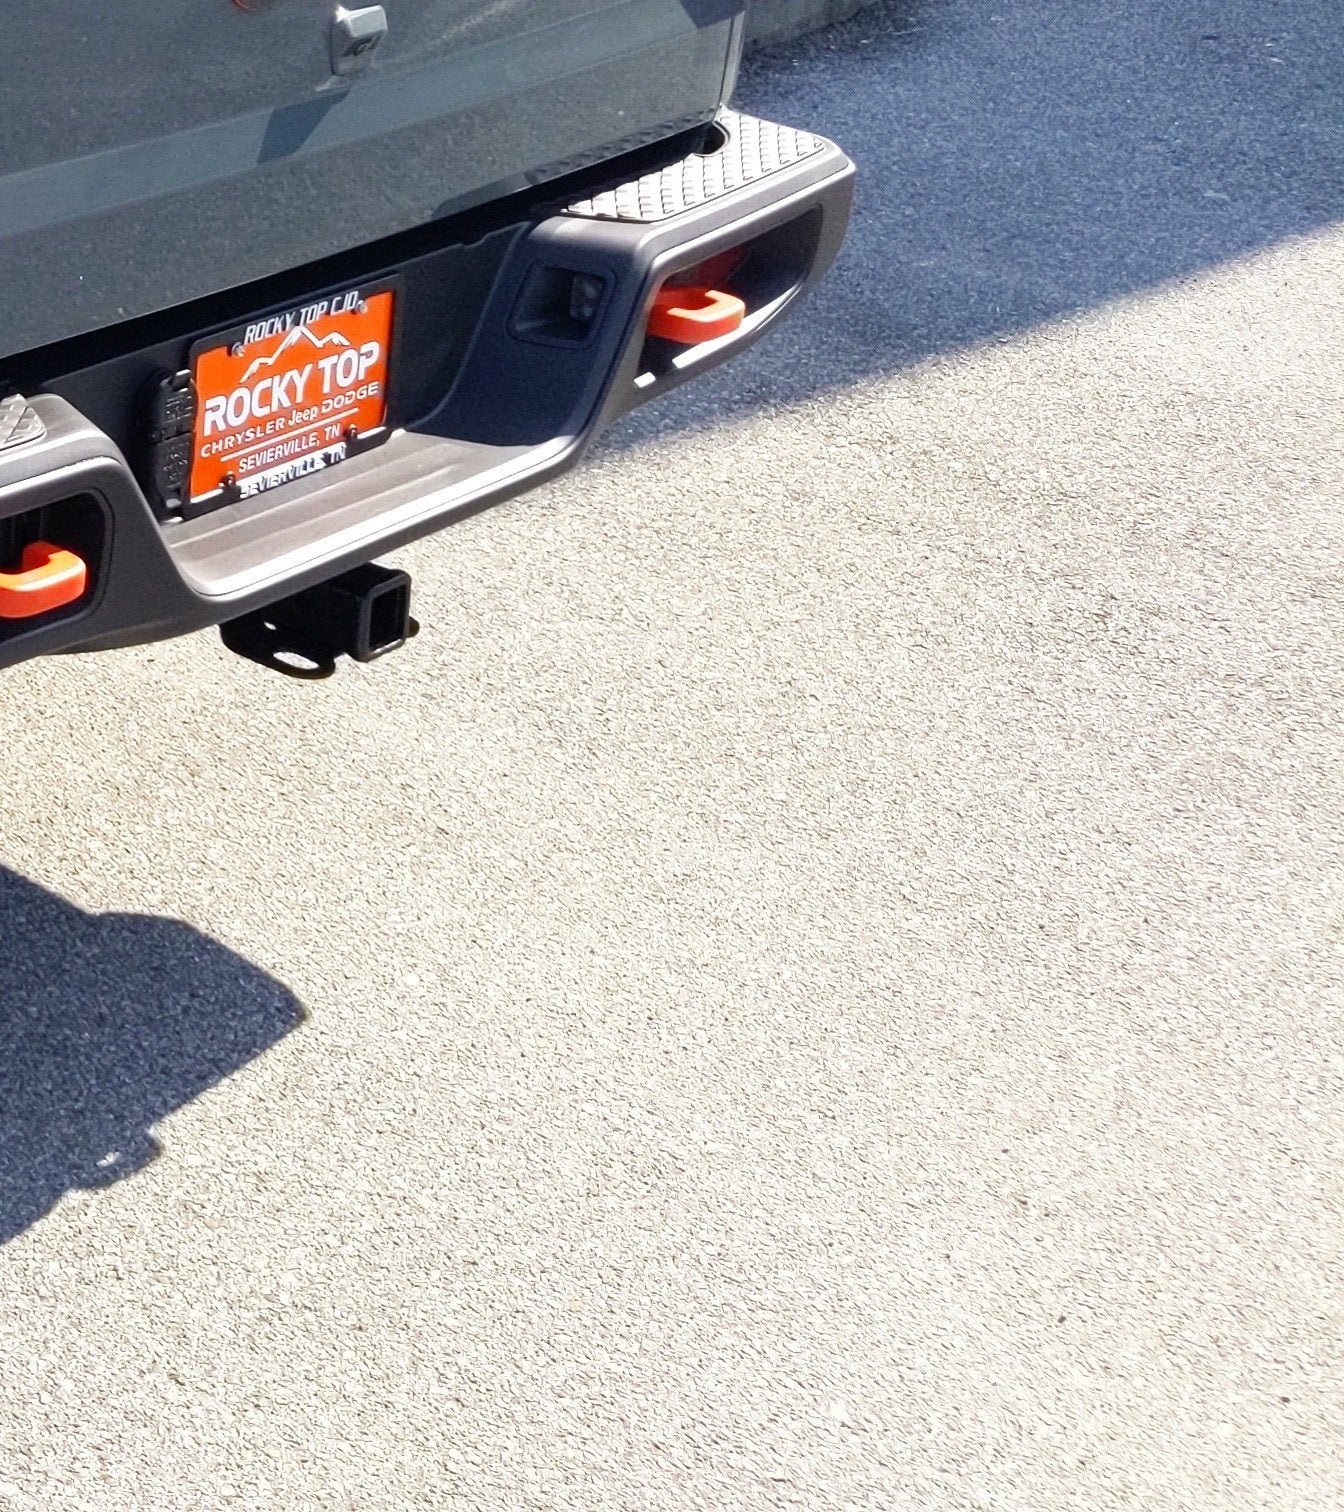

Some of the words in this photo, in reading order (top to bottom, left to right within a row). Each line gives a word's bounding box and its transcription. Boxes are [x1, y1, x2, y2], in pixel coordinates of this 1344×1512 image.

[244, 312, 295, 345] ROCKY
[299, 301, 328, 327] TOP
[203, 364, 312, 437] ROCKY
[317, 341, 381, 394] TOP
[200, 417, 285, 458] CHRYSLER
[287, 405, 317, 428] Jeep
[321, 381, 379, 414] DODGE
[238, 432, 320, 474] SEVIERVILLE,
[323, 423, 342, 442] TN
[329, 445, 347, 464] TN
